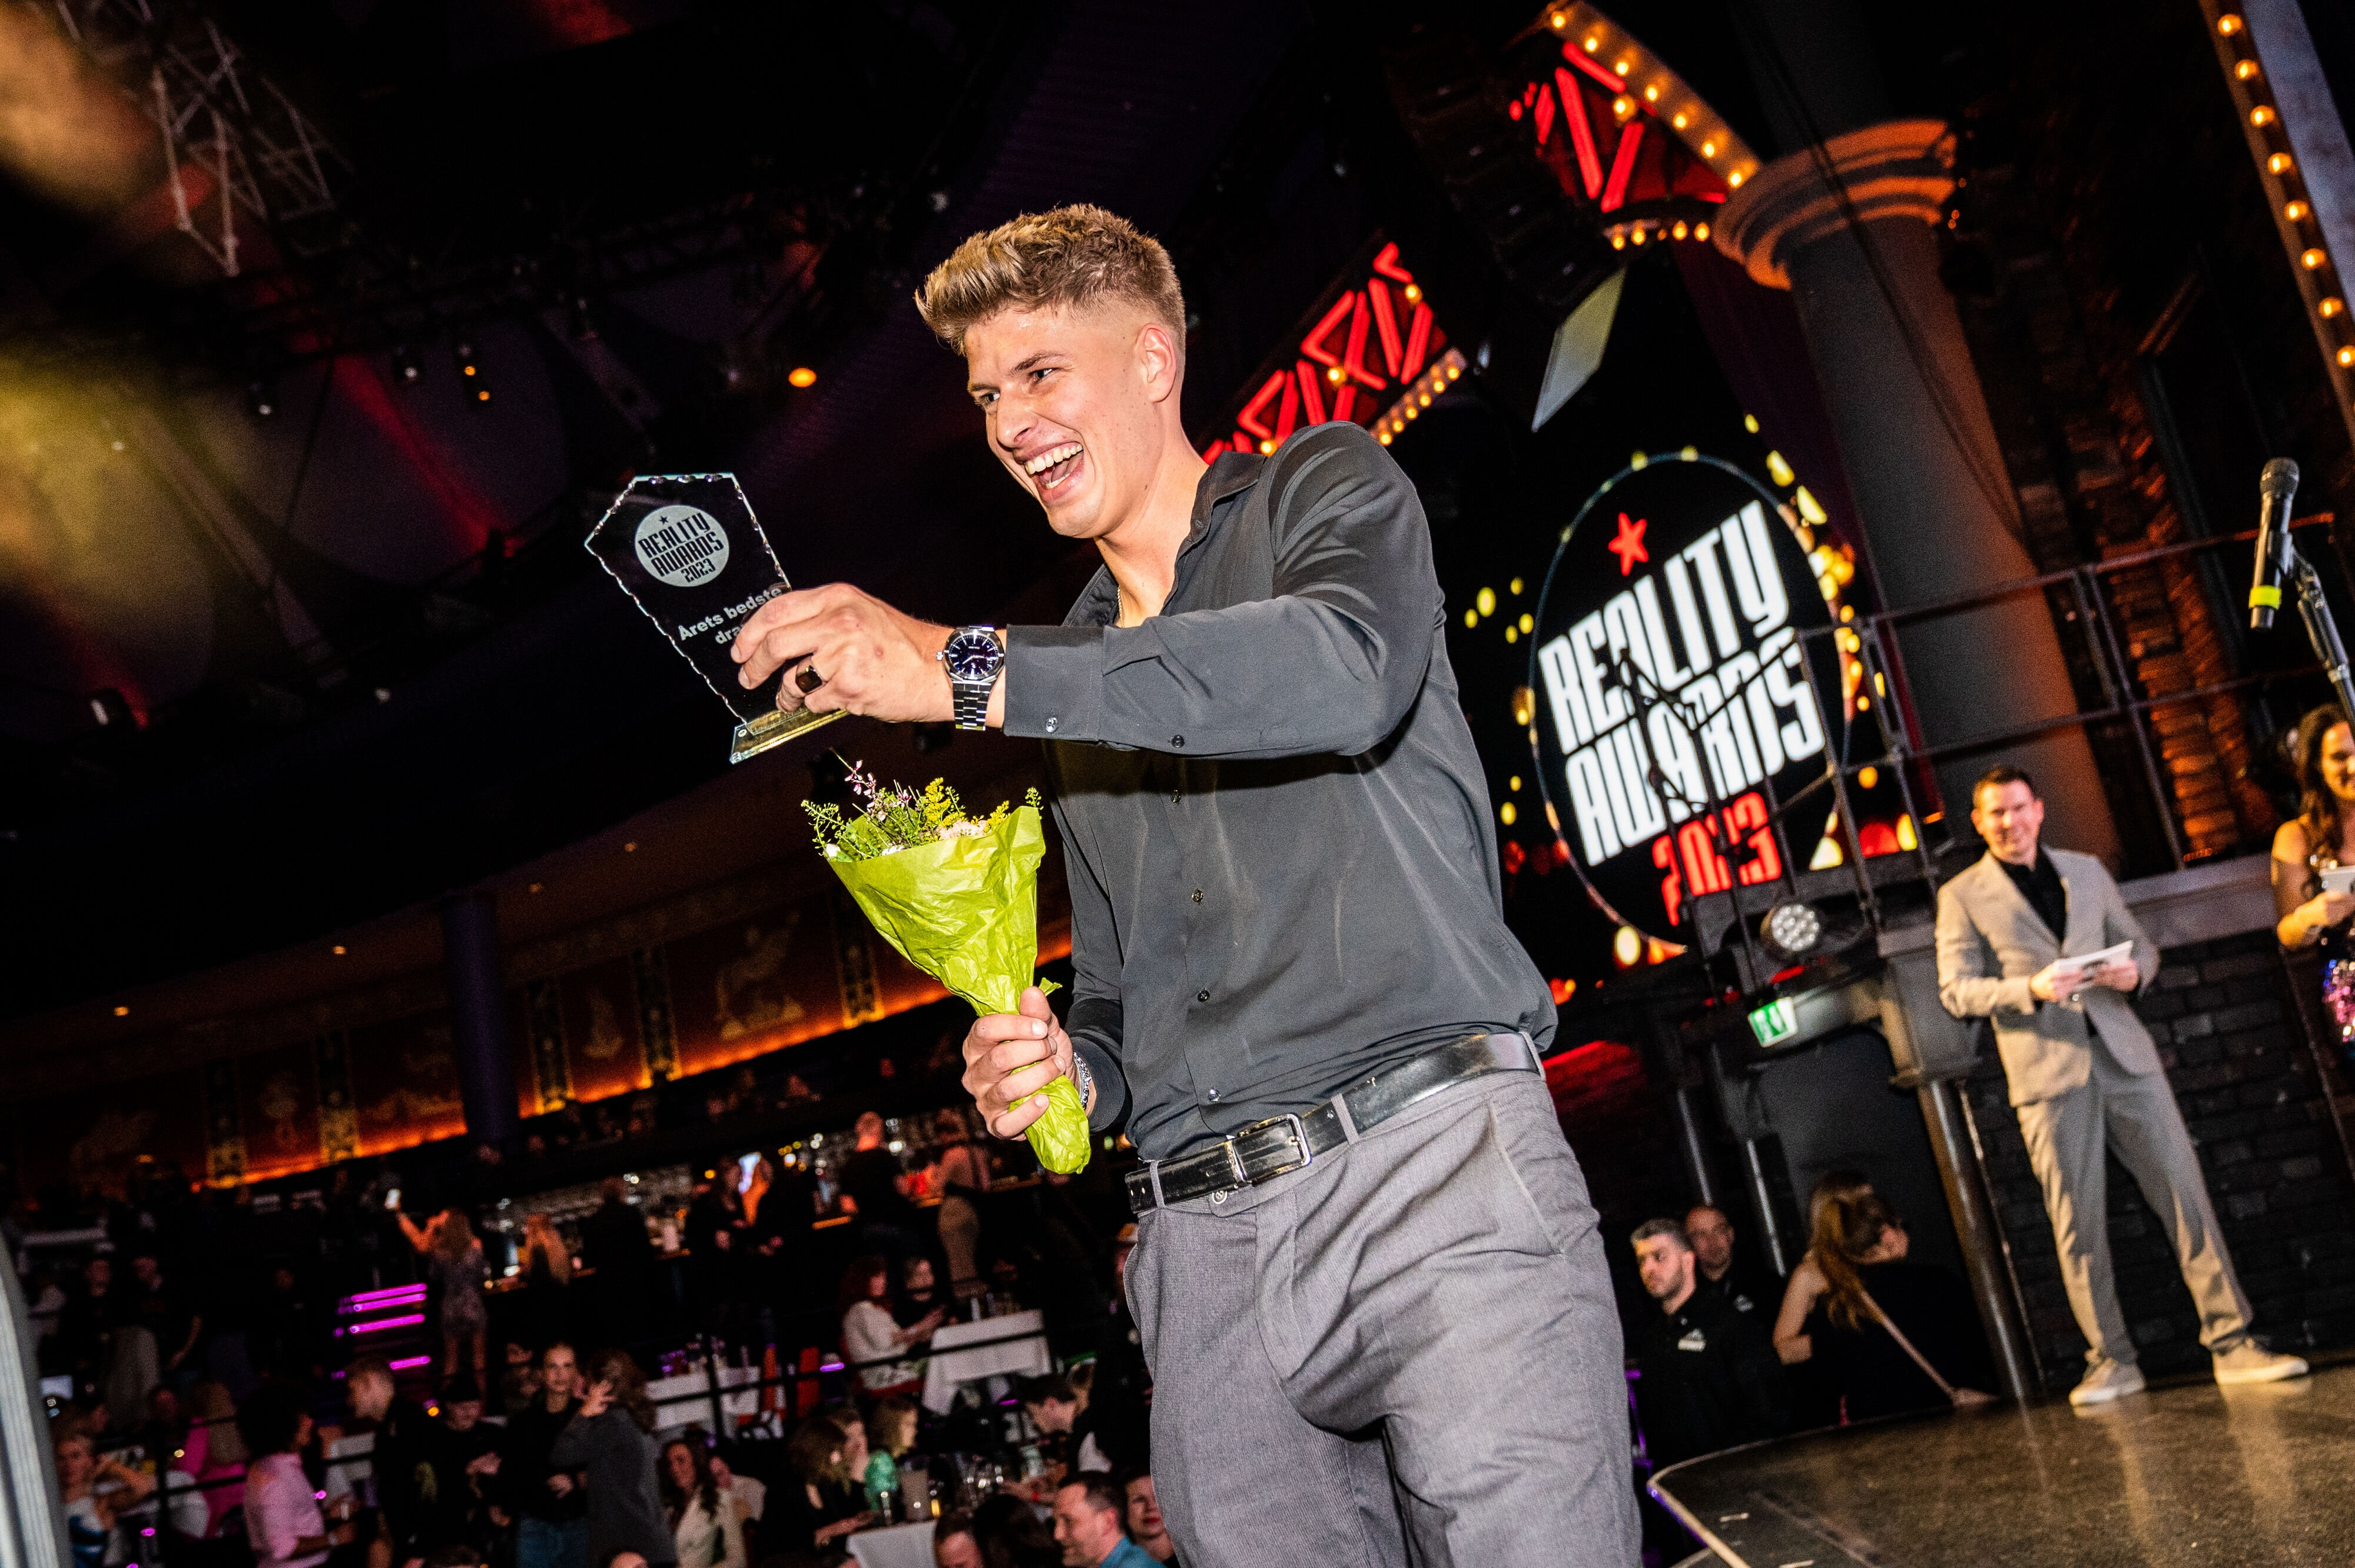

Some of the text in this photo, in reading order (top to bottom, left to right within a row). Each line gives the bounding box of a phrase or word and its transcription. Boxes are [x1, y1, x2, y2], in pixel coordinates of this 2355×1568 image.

[638, 513, 711, 558] REALITY
[651, 531, 724, 577] AWARDS
[681, 558, 716, 583] 2023
[678, 588, 782, 640] Årets bedste
[715, 623, 744, 644] dra
[1538, 499, 1789, 755] REALITY
[1565, 626, 1826, 866] AWARDS
